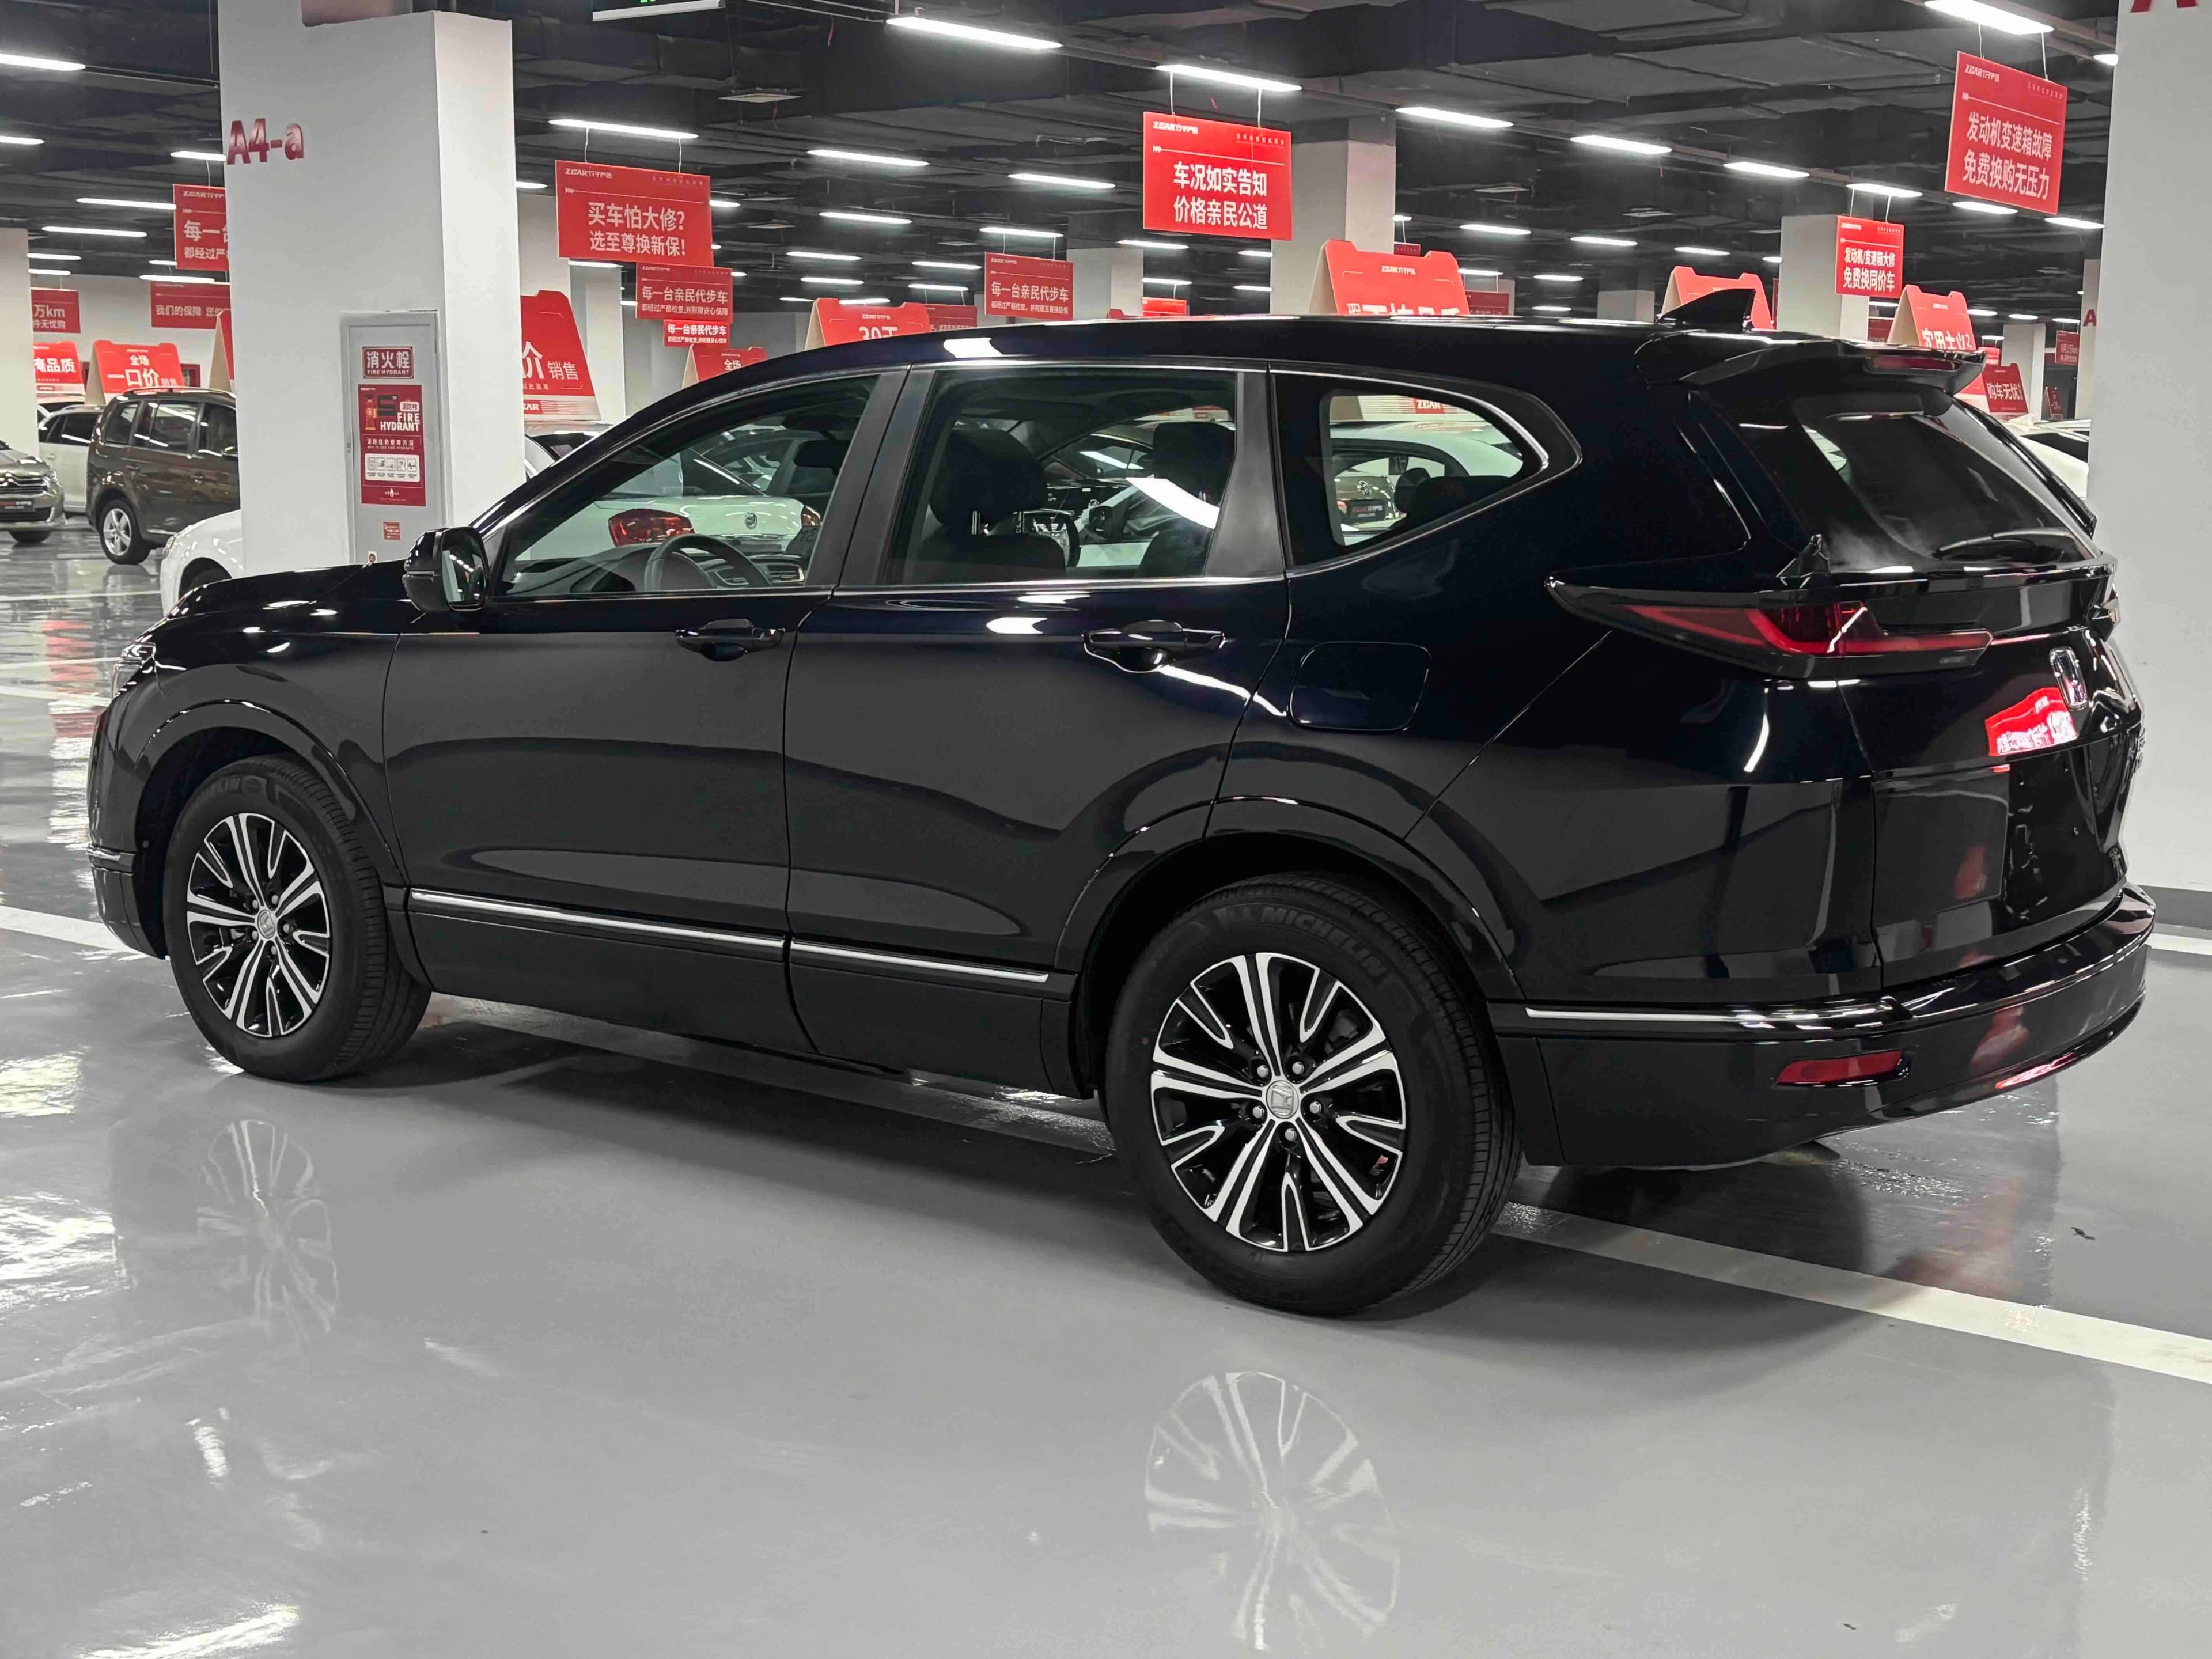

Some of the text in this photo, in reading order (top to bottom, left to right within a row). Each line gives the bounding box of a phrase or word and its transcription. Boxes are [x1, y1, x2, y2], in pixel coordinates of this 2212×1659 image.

[227, 118, 304, 165] A4-a
[1966, 111, 2053, 161] 发动机变速箱故障
[1173, 161, 1267, 197] 车况如实告知
[1963, 149, 2050, 200] 免费换购无压力
[588, 202, 685, 232] 买车怕大修?
[1173, 195, 1268, 230] 价格亲民公道
[184, 247, 228, 260] 都经过严
[589, 230, 686, 257] 选至尊换新保!
[1843, 266, 1896, 293] 免费换同价车
[641, 286, 728, 304] 每一台亲民代步车
[991, 281, 1069, 303] 每一台亲民代步车
[667, 323, 727, 336] 每一台亲民代步车
[129, 354, 150, 366] 全场
[366, 350, 410, 369] 消火栓
[547, 360, 579, 381] 销售
[107, 368, 160, 388] 一口价
[380, 421, 421, 433] HYDRANT
[397, 412, 421, 422] FIRE
[1259, 905, 1388, 978] MICHELIN
